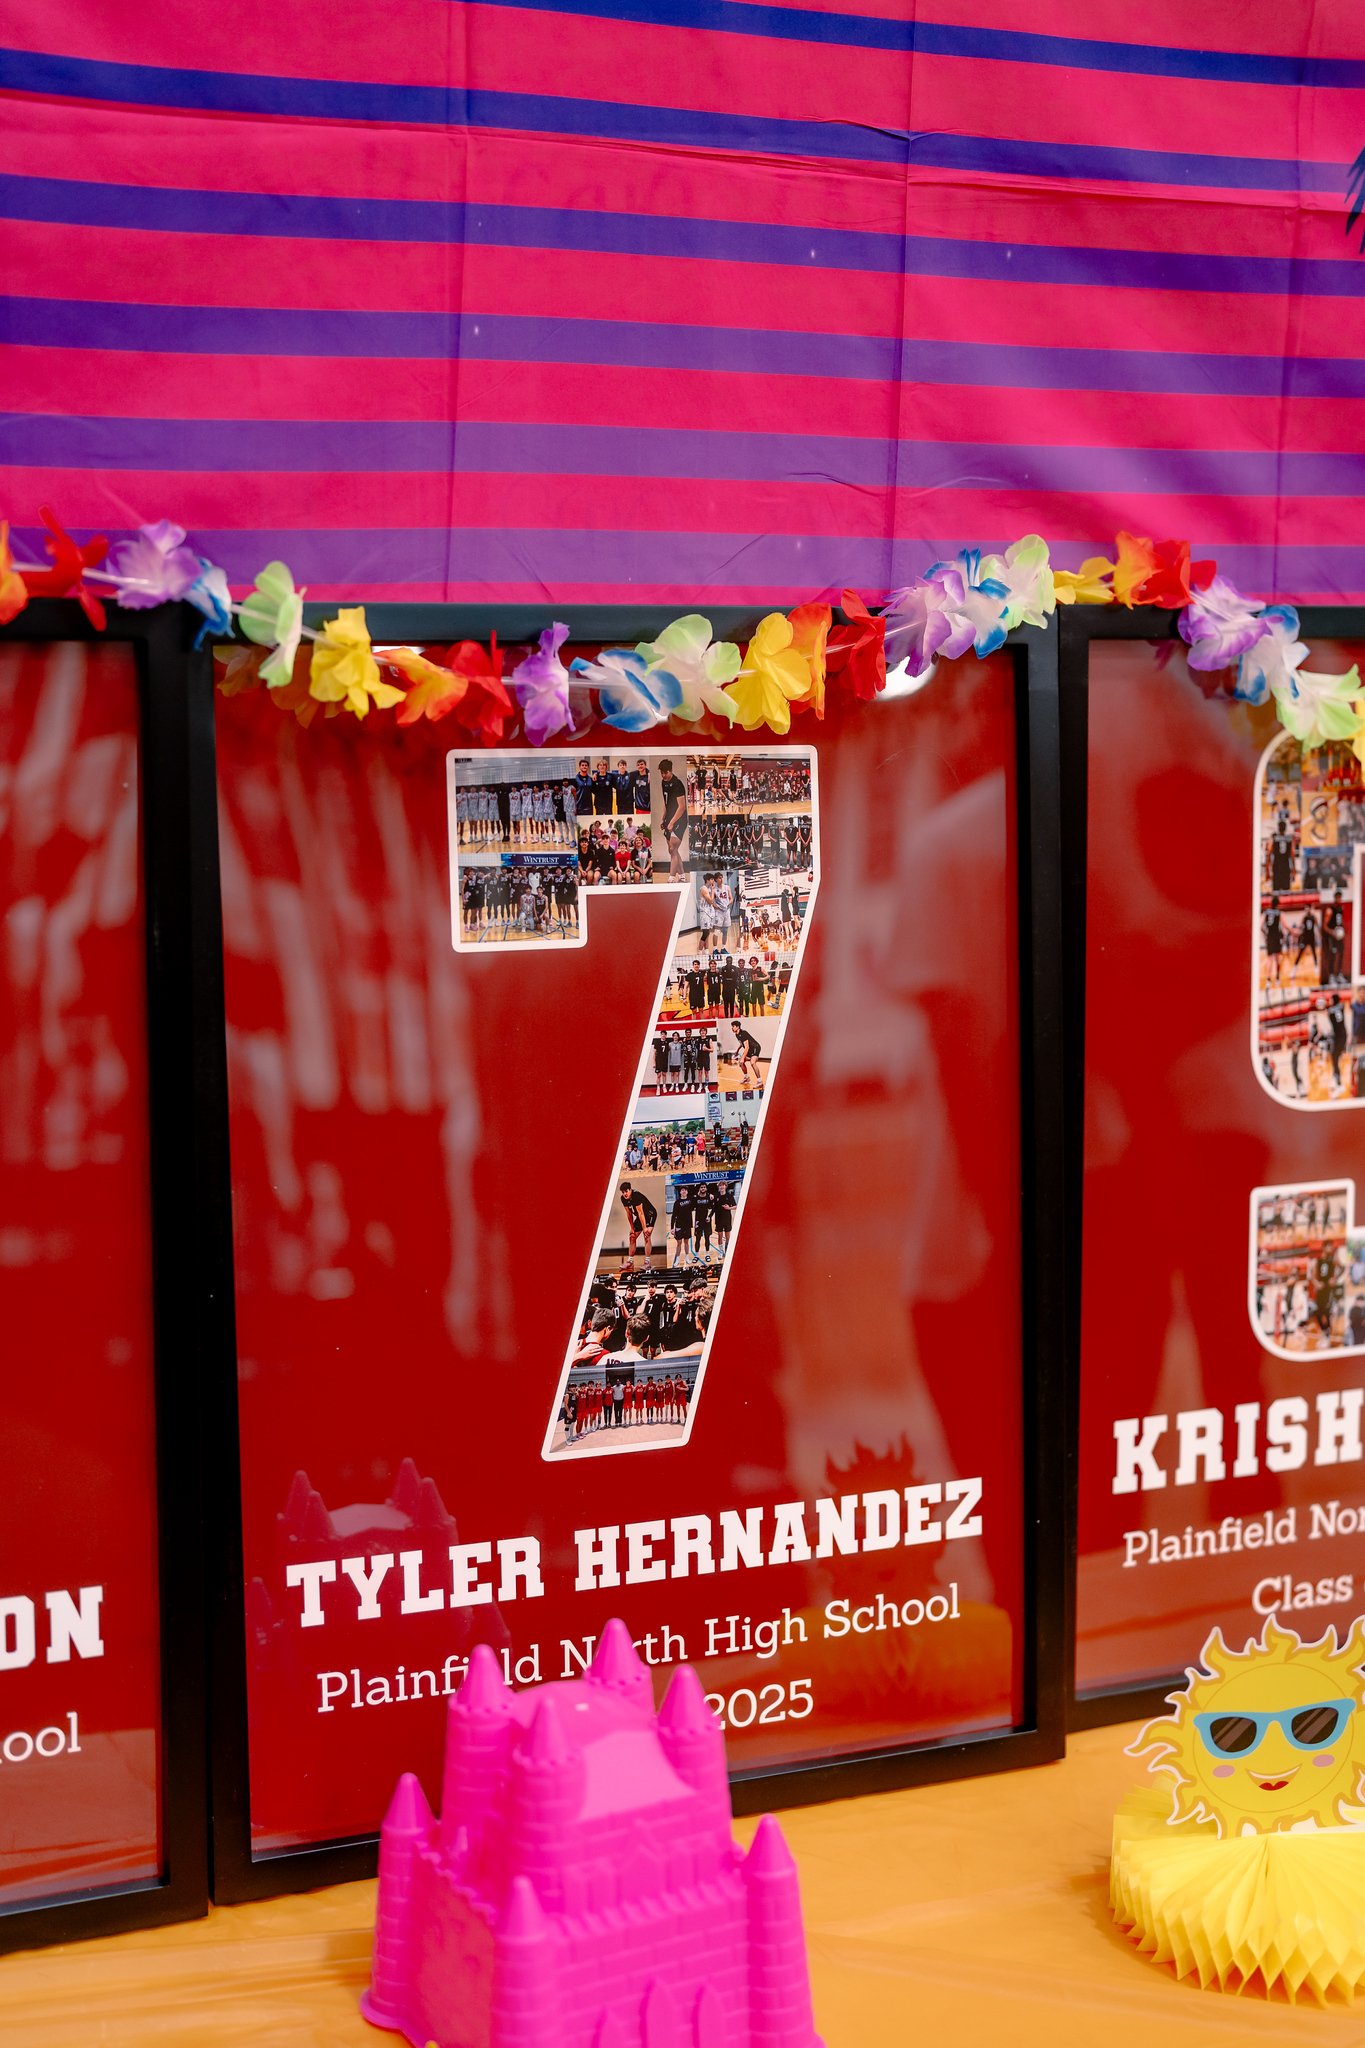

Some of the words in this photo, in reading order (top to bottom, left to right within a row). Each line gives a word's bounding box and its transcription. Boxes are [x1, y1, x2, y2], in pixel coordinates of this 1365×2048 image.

[446, 744, 820, 1462] 7
[694, 1171, 729, 1180] WINTRUST
[648, 1303, 654, 1314] 7
[1112, 1387, 1364, 1495] KRISH
[286, 1535, 544, 1628] TYLER
[575, 1476, 983, 1592] HERNANDEZ
[1122, 1507, 1298, 1568] Plainfield
[1252, 1574, 1353, 1615] Class
[316, 1643, 543, 1713] Plainfild
[560, 1625, 688, 1678] Nth
[704, 1608, 808, 1659] High
[823, 1582, 961, 1639] School
[703, 1678, 814, 1731] 2025
[0, 1711, 81, 1764] ool
